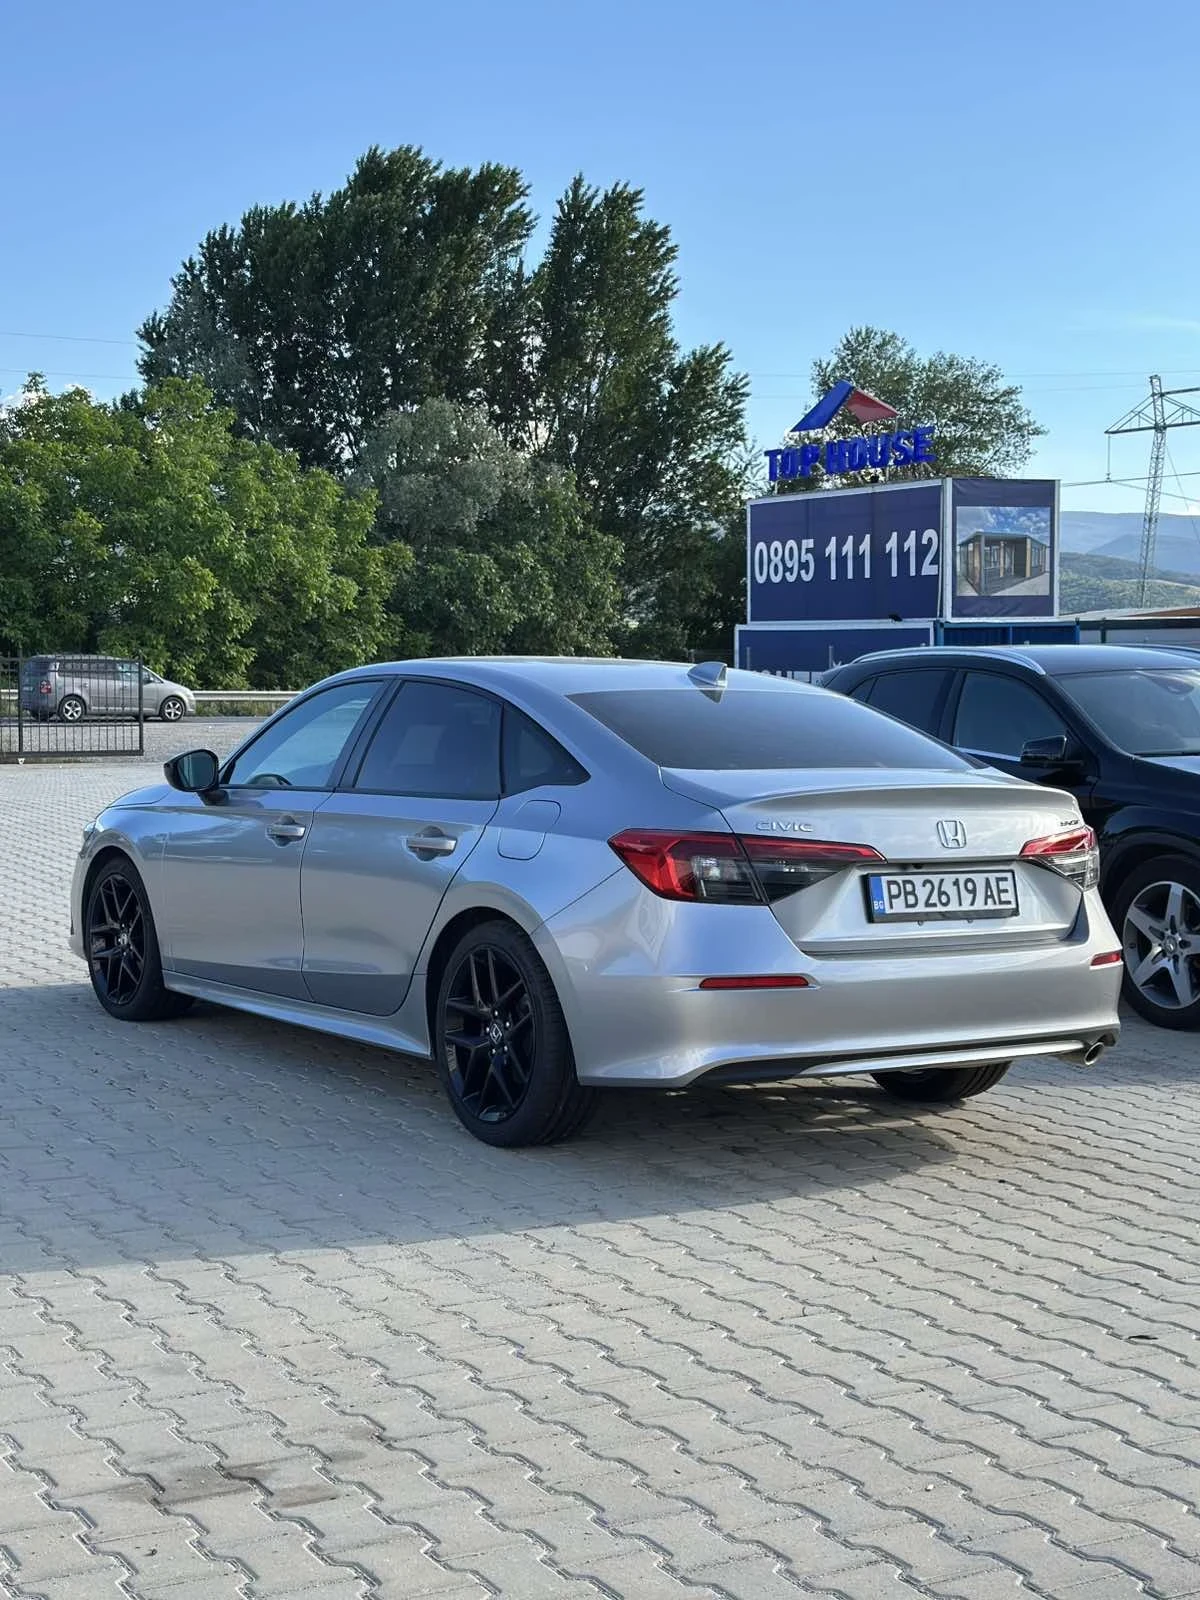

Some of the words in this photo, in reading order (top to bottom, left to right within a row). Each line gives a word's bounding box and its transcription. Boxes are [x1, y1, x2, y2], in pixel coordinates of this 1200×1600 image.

[764, 444, 820, 482] TOP
[826, 427, 937, 475] HOUSE
[754, 538, 815, 584] 0895
[825, 534, 871, 580] 111
[885, 528, 939, 578] 112
[756, 820, 814, 833] CIVIC
[873, 900, 884, 910] BG
